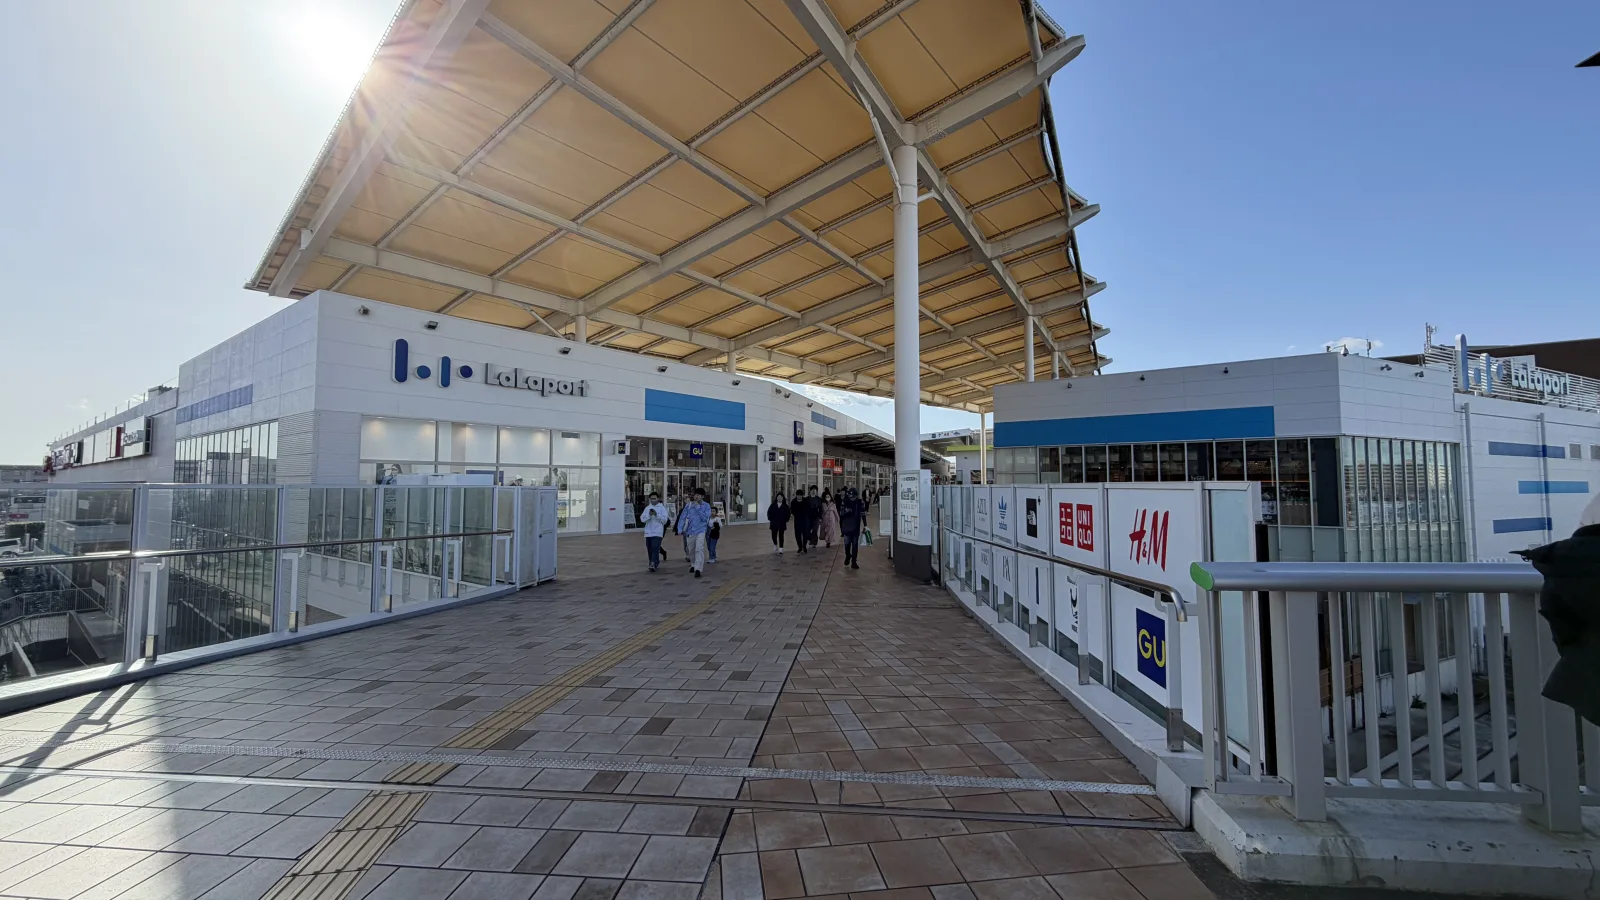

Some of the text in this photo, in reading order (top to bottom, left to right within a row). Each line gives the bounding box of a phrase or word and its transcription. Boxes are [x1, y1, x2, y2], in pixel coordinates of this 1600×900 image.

[485, 362, 589, 397] LaLaport
[1510, 358, 1571, 399] LaLaport
[1078, 510, 1091, 526] UNI
[1078, 527, 1093, 547] QLO
[1128, 508, 1169, 573] H&M
[1138, 628, 1166, 668] GU
